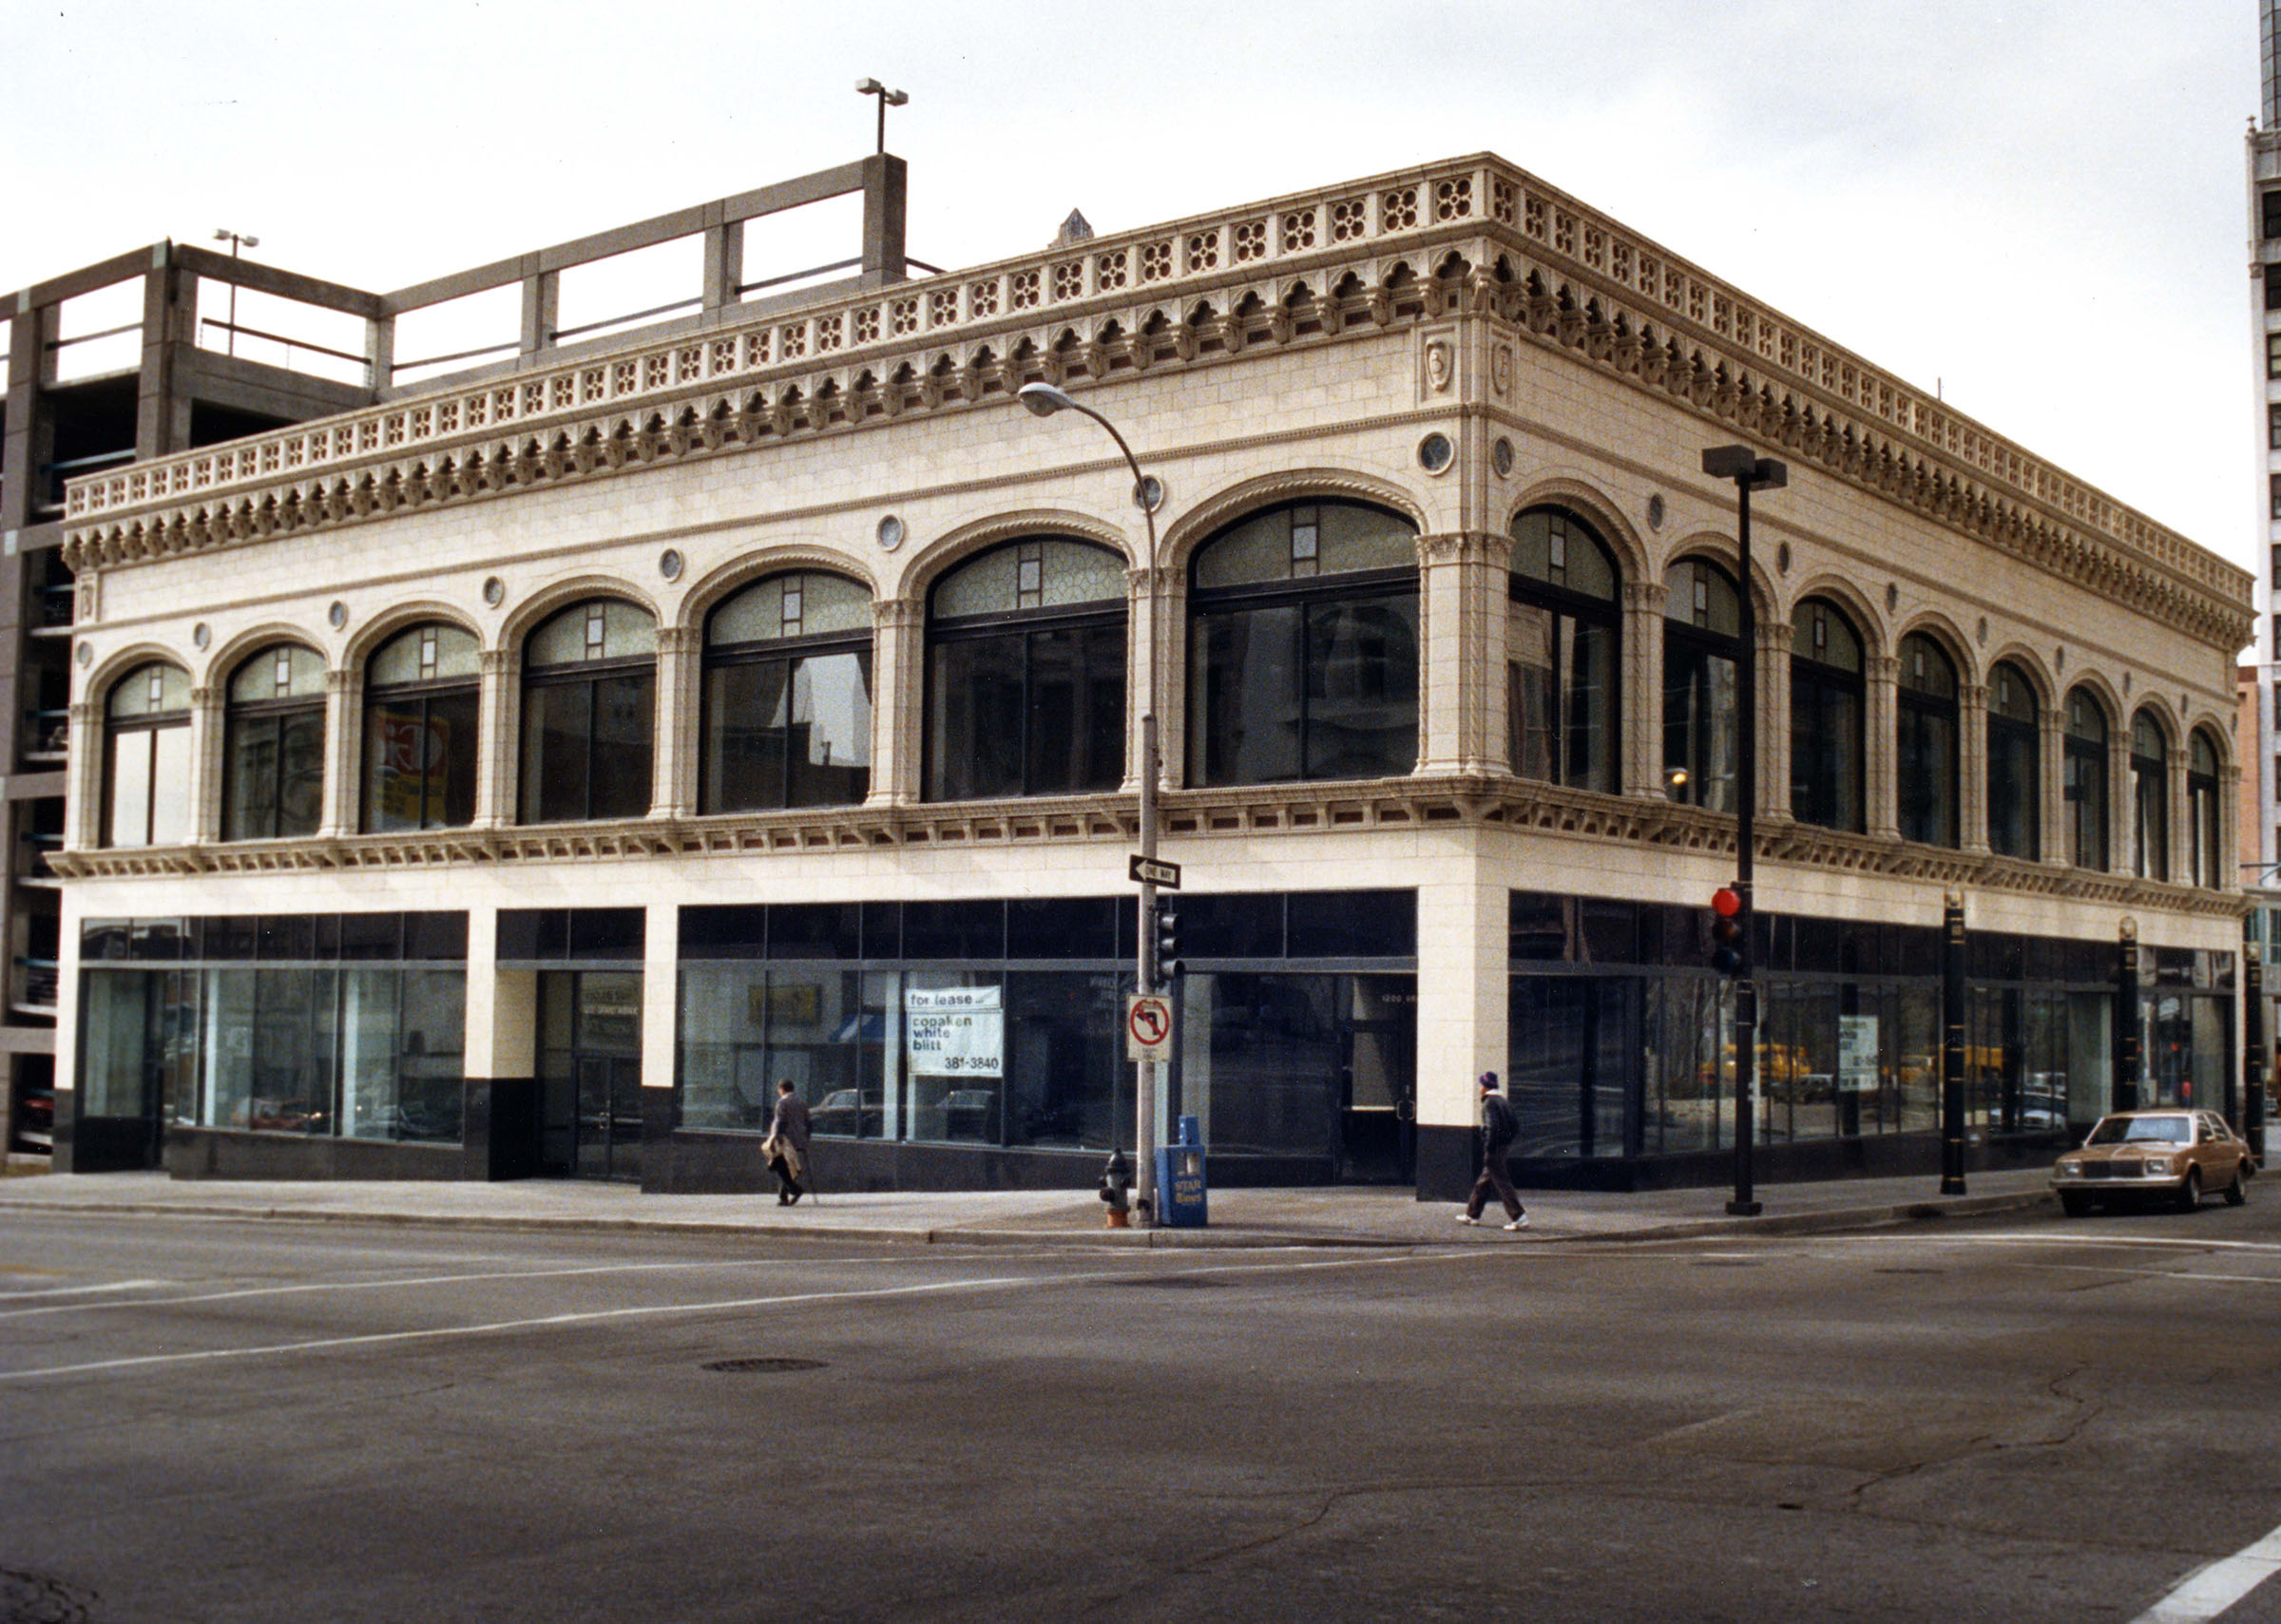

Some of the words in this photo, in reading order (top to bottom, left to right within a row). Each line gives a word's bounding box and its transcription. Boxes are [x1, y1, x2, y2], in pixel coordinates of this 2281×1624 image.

[910, 994, 929, 1005] for
[913, 1026, 950, 1038] white
[912, 1039, 942, 1051] blitt
[945, 1057, 999, 1070] 381-3840
